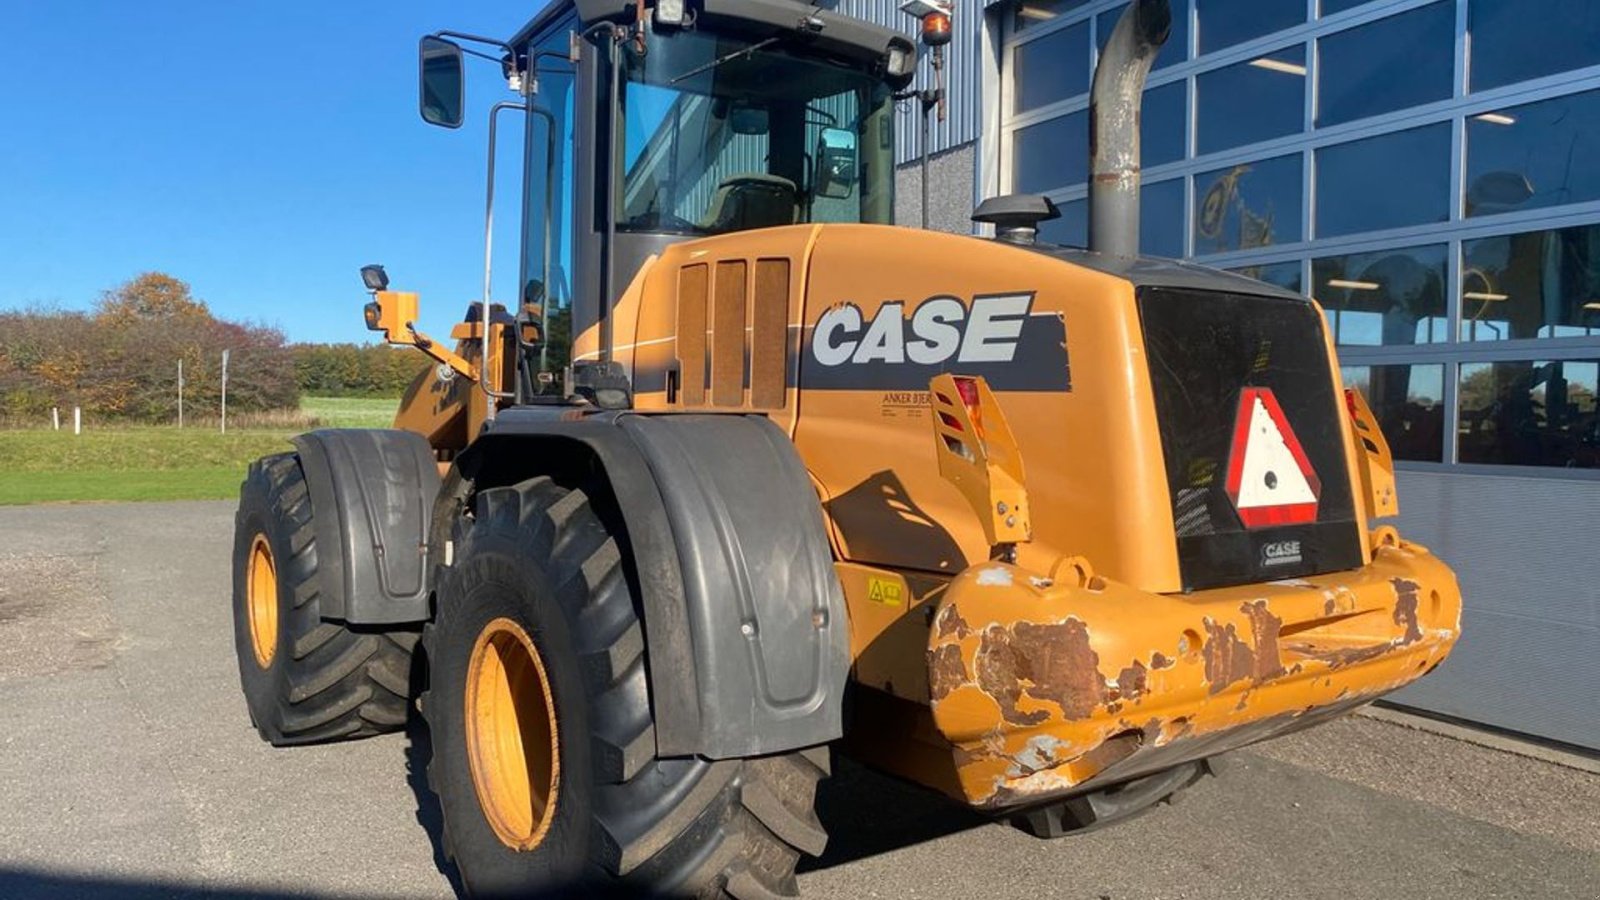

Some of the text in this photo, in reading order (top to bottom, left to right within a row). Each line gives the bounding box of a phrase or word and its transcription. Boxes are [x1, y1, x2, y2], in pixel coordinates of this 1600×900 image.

[812, 294, 1033, 366] CASE
[883, 392, 912, 404] ANKER
[1265, 541, 1301, 558] CASE
